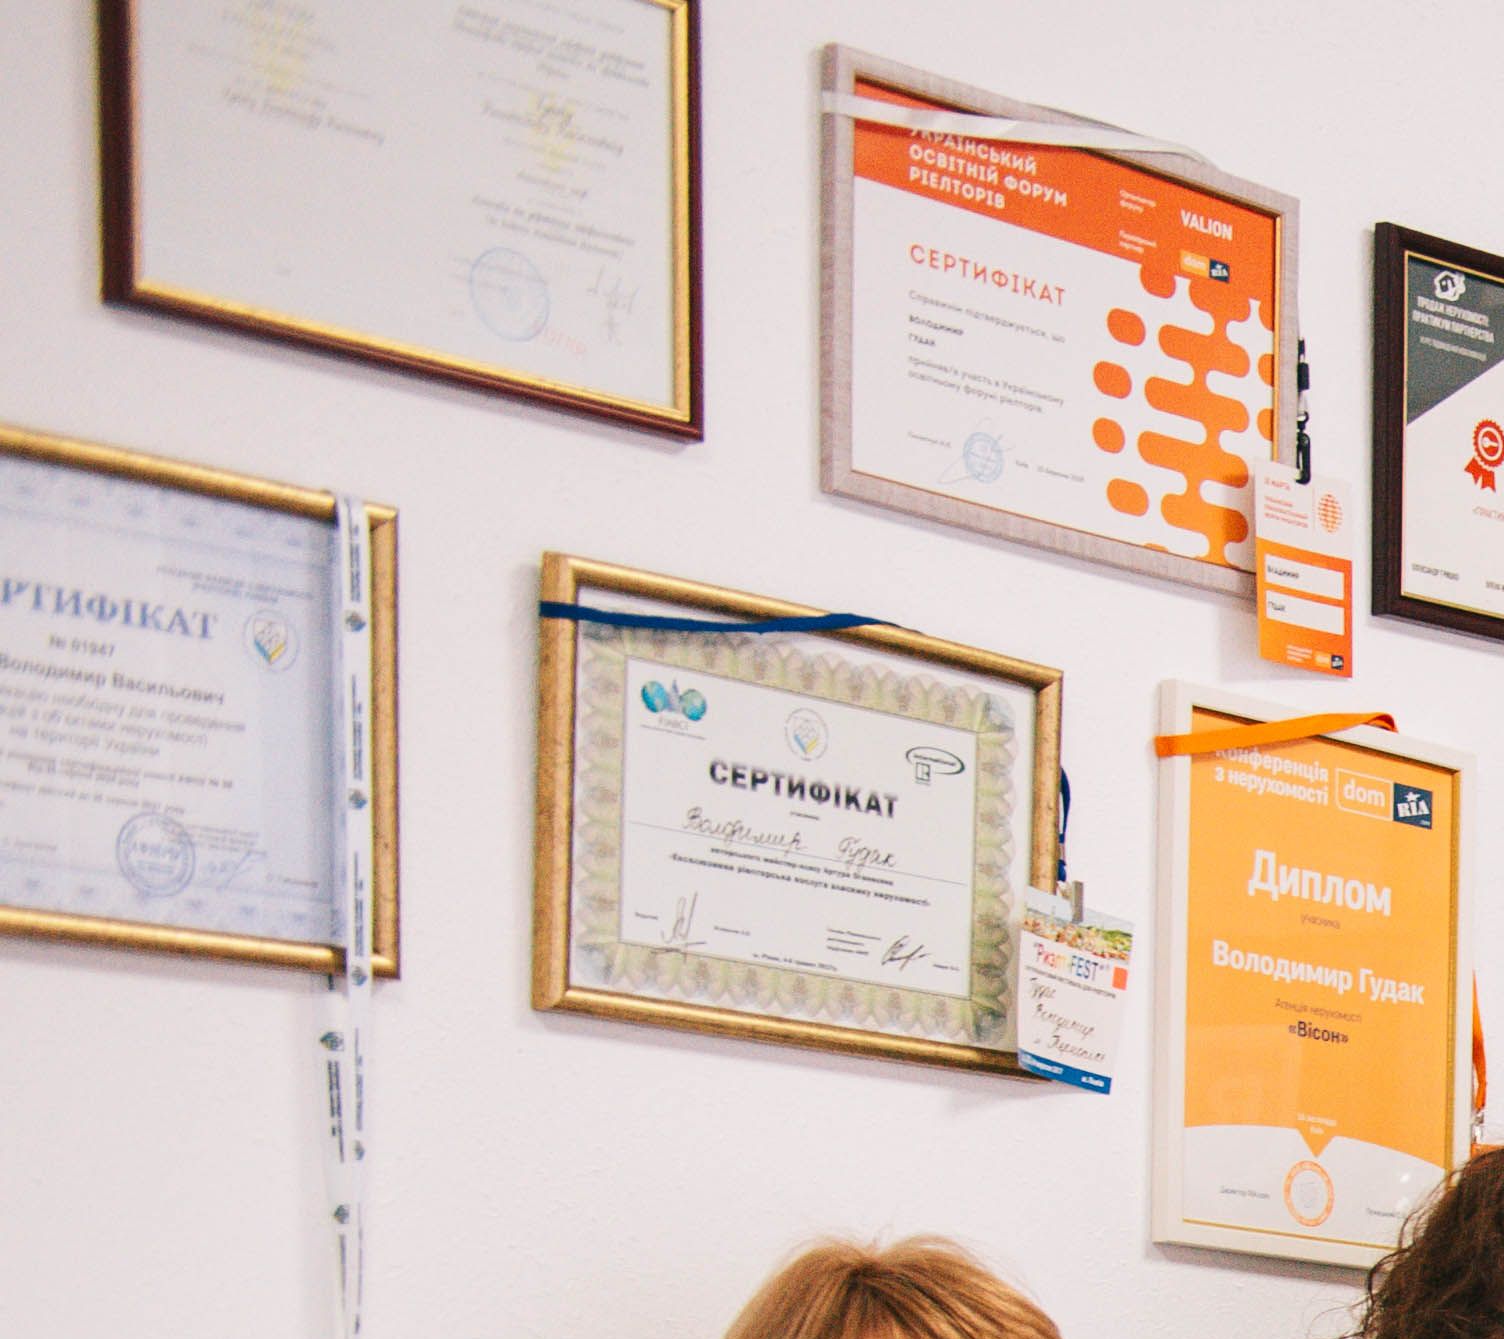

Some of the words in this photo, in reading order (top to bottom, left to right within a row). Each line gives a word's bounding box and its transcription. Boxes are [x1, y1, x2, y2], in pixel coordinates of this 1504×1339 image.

[909, 143, 999, 185] ОСВІТНІЙ
[1004, 175, 1068, 207] ФОРУМ
[1181, 209, 1233, 241] VALION
[910, 243, 1066, 305] СЕРТИФІКАТ
[0, 578, 219, 640] РТИФІКАТ
[112, 672, 225, 705] Васильович
[710, 759, 899, 819] СЕРТИФІКАТ
[1228, 770, 1329, 806] нерухомості
[1343, 780, 1385, 808] dom
[1397, 799, 1429, 818] RIA
[1248, 849, 1391, 917] Диплом
[1212, 940, 1352, 994] Володимир
[1359, 968, 1425, 1005] Гудак
[1288, 1021, 1349, 1044] «Вісон»
